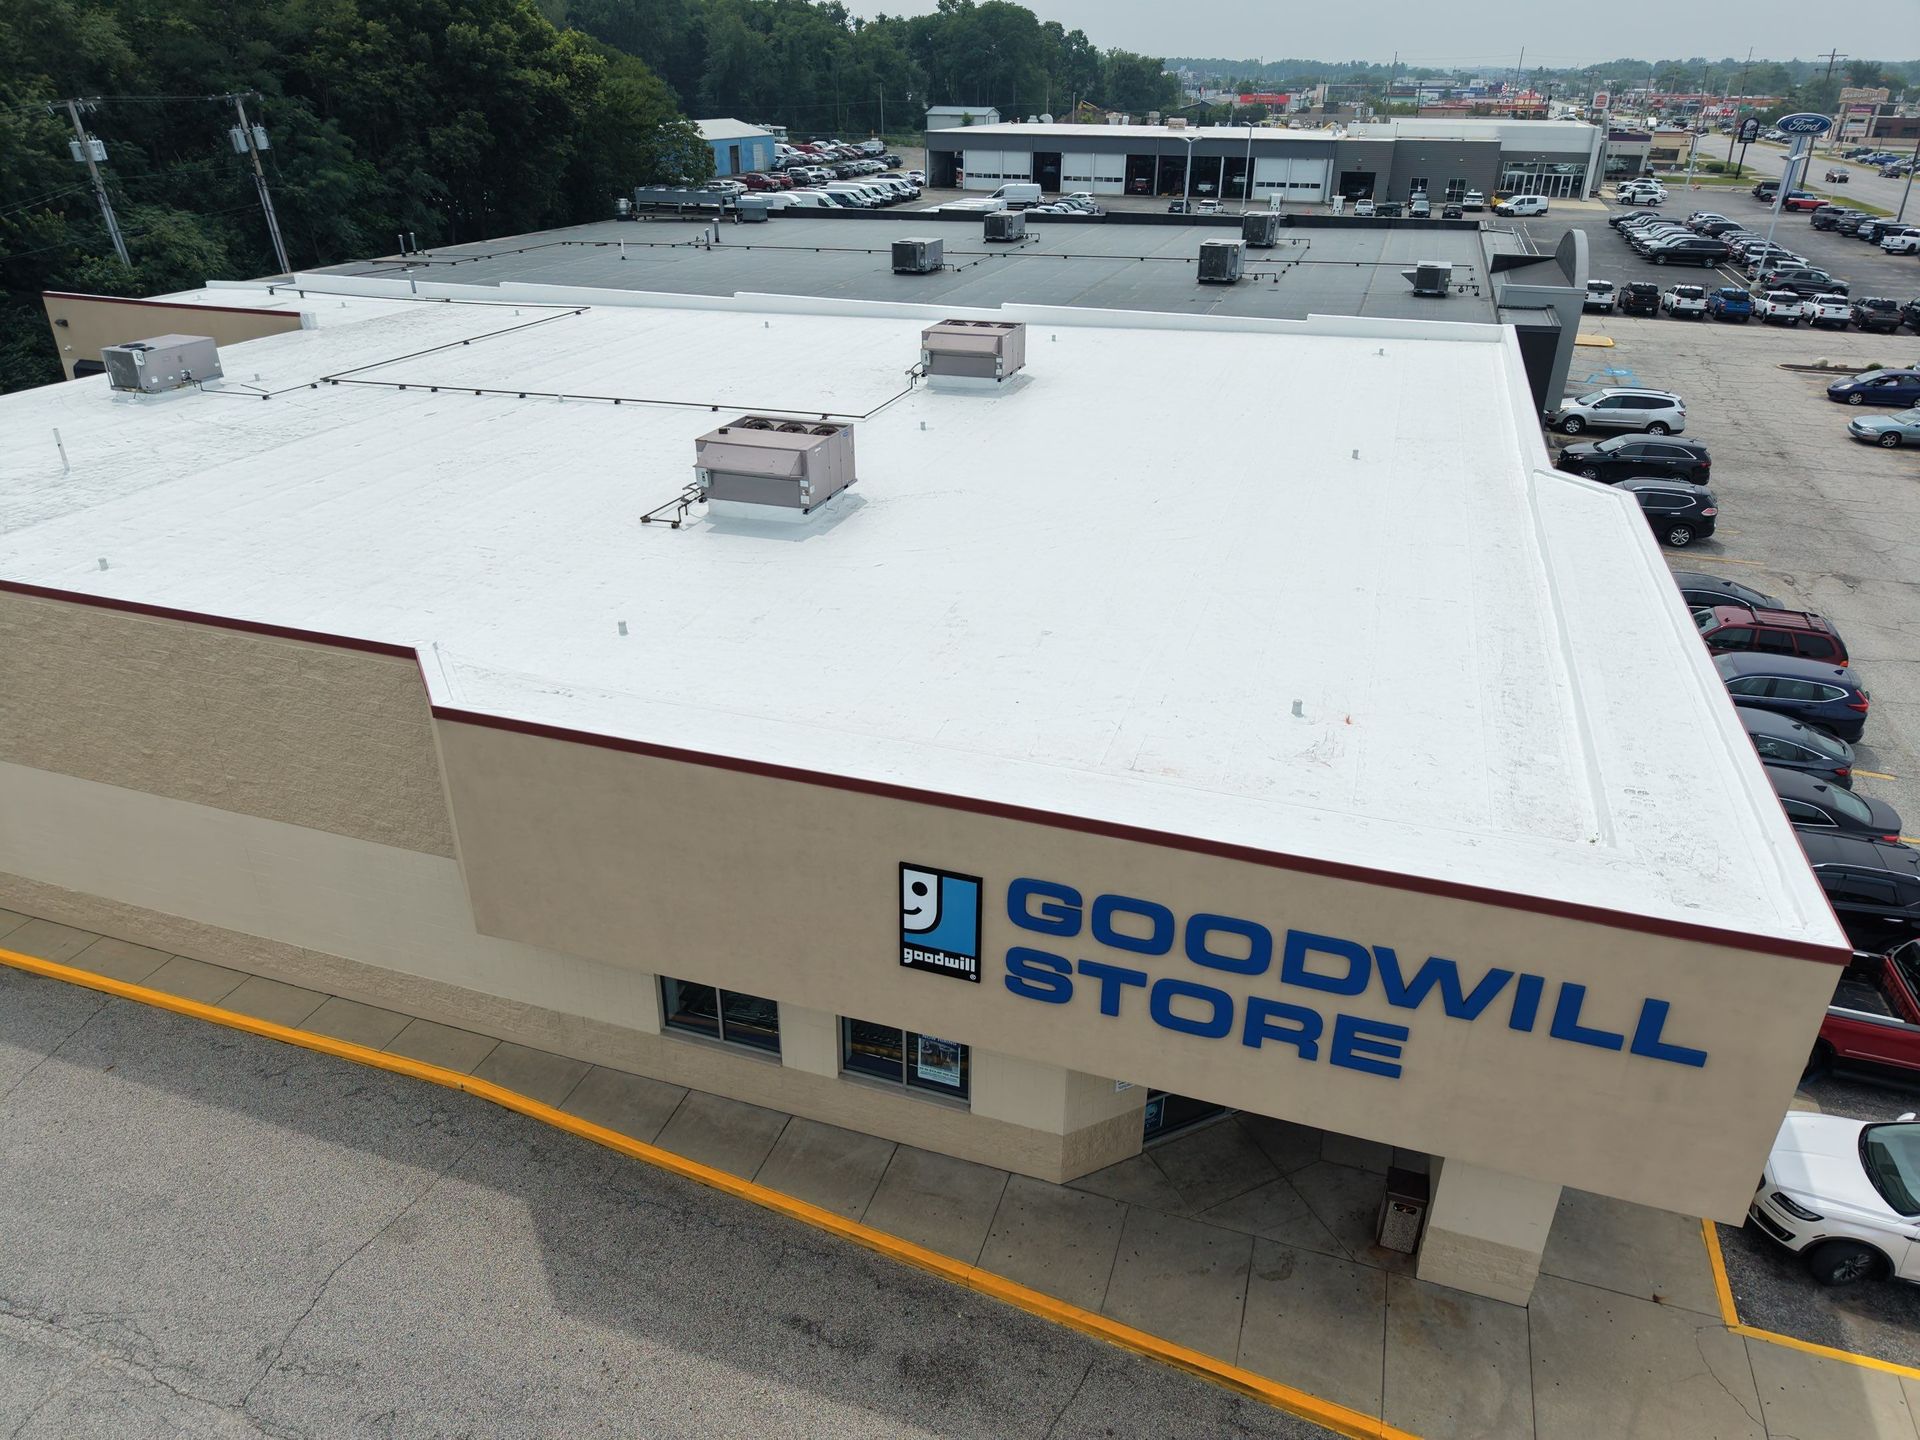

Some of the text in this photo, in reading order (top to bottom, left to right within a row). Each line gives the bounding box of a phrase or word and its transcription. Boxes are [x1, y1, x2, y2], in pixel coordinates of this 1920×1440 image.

[1788, 117, 1822, 131] Ford
[903, 947, 976, 973] goodwill
[1006, 877, 1708, 1068] GOODWILL
[1004, 946, 1410, 1079] STORE
